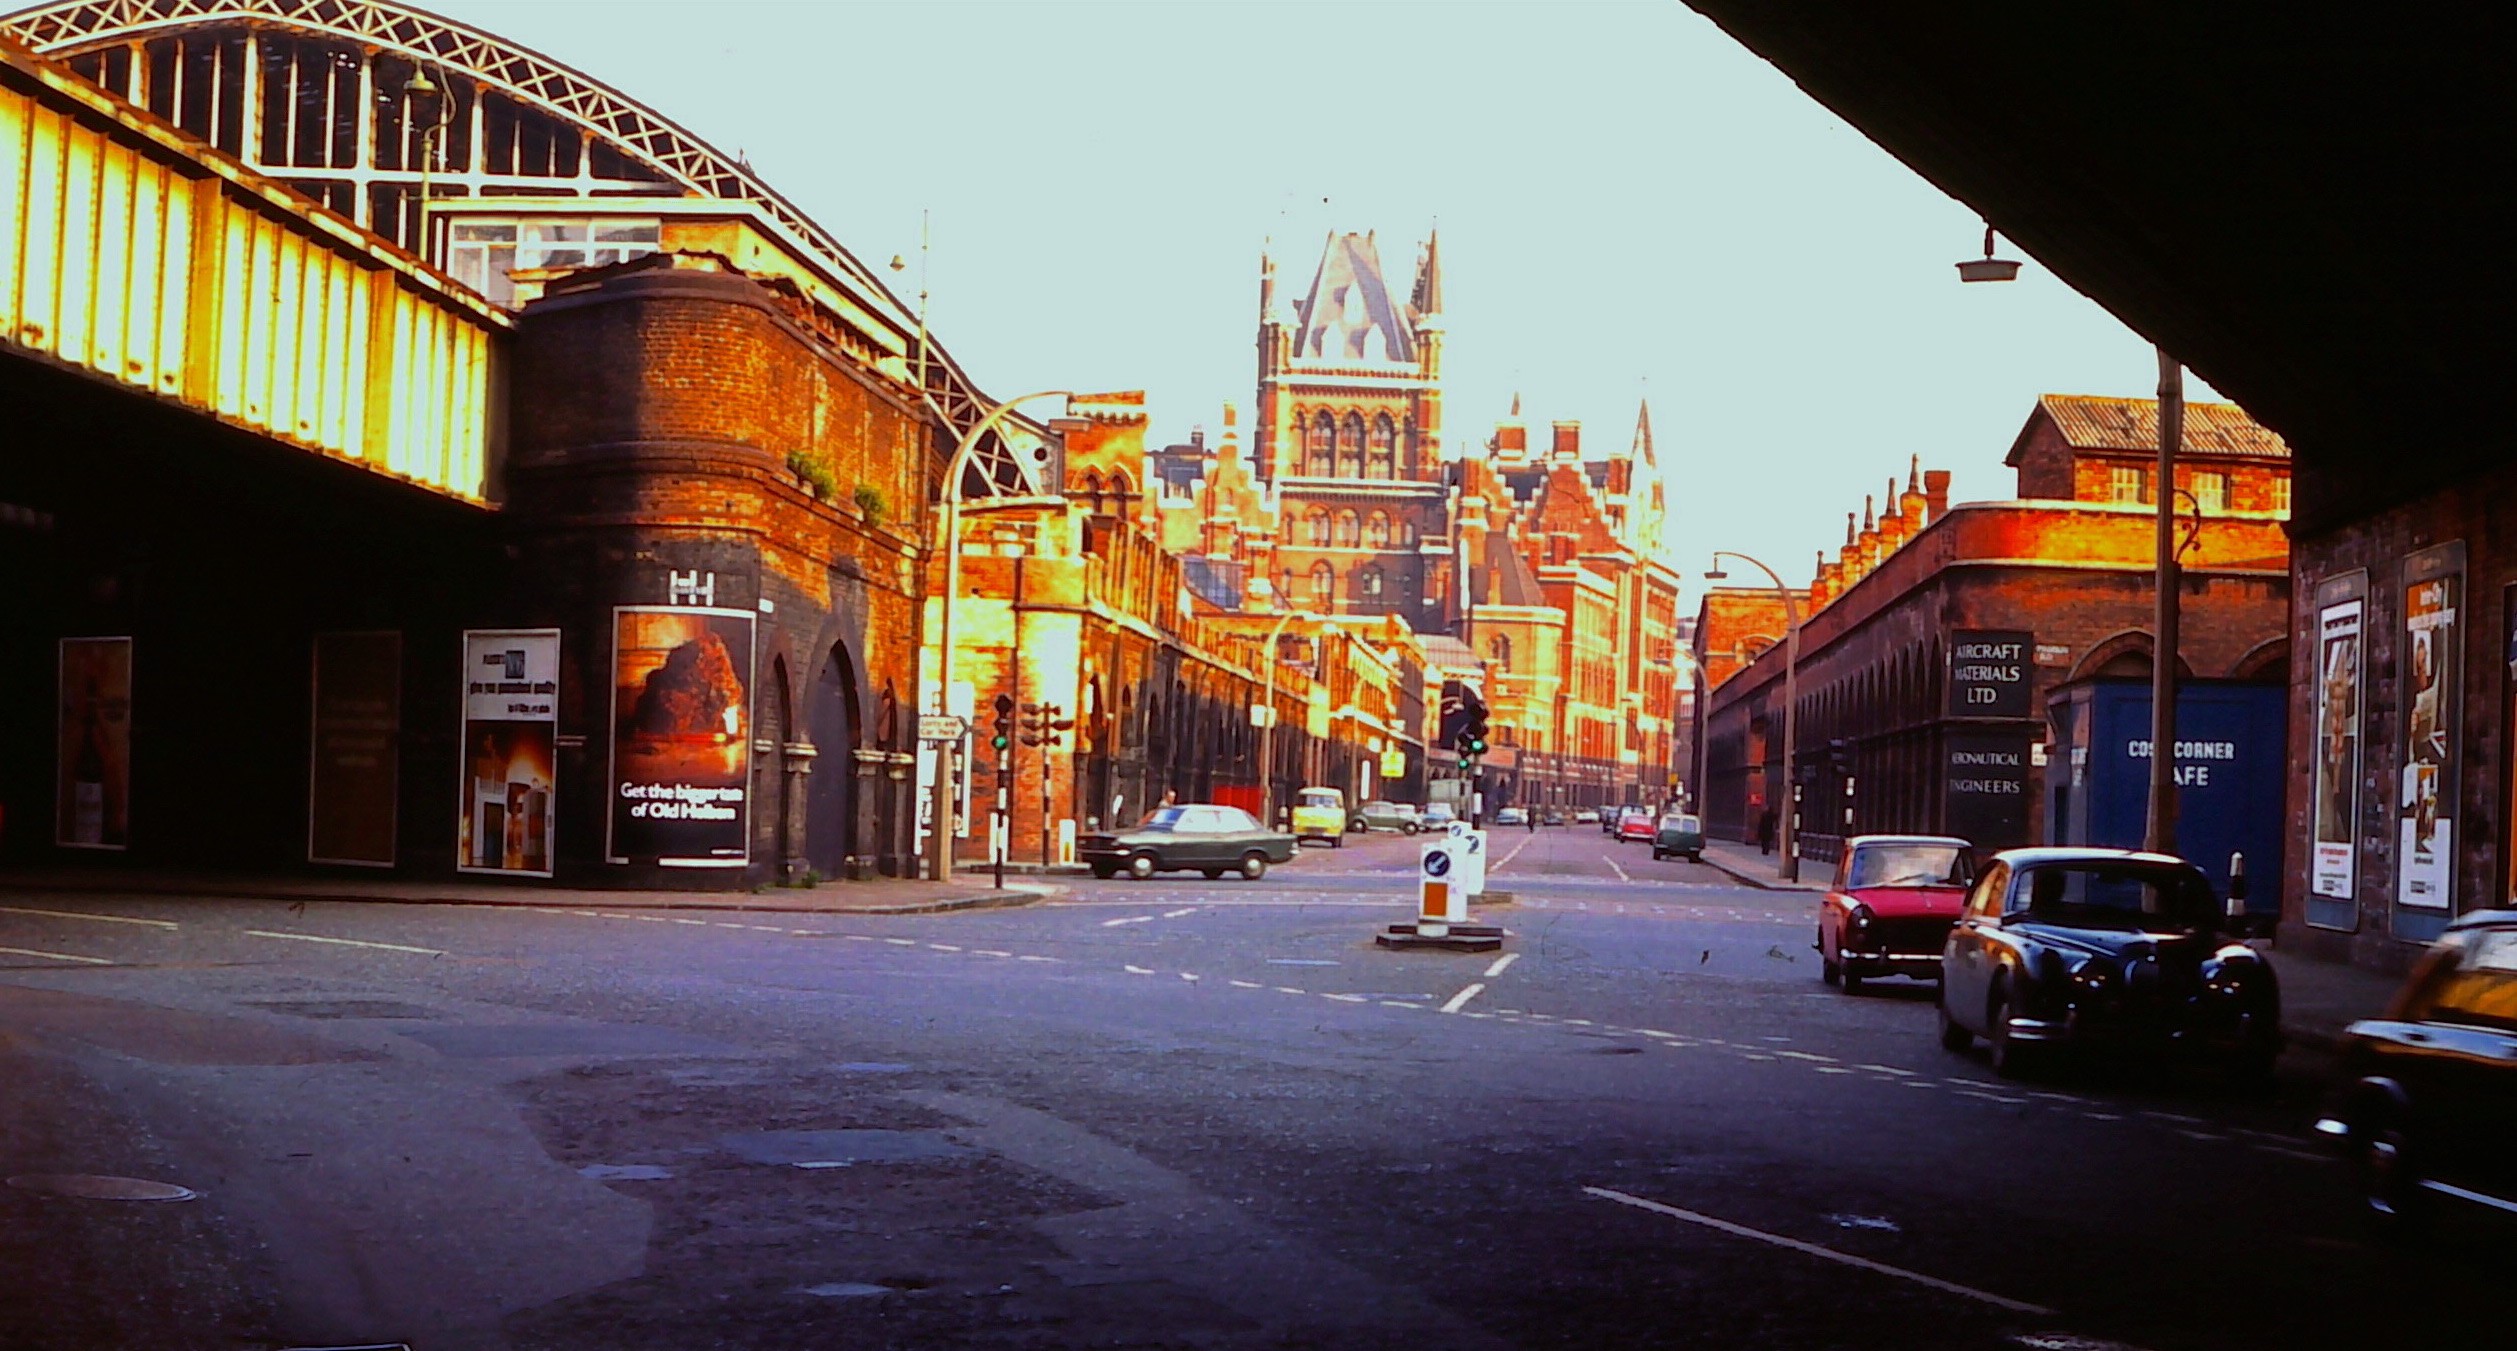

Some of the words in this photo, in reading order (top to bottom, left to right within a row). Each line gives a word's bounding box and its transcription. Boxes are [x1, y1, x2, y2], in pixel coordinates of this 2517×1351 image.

[1956, 644, 2022, 660] AIRCRAFT
[1955, 665, 2021, 682] MATERIALS
[1967, 687, 1997, 703] LTD
[2128, 740, 2154, 757] COS
[2174, 741, 2234, 759] CORNER
[2173, 766, 2209, 786] AFE
[621, 783, 647, 798] Get
[648, 784, 674, 799] the
[631, 803, 648, 817] of
[650, 803, 679, 818] Old
